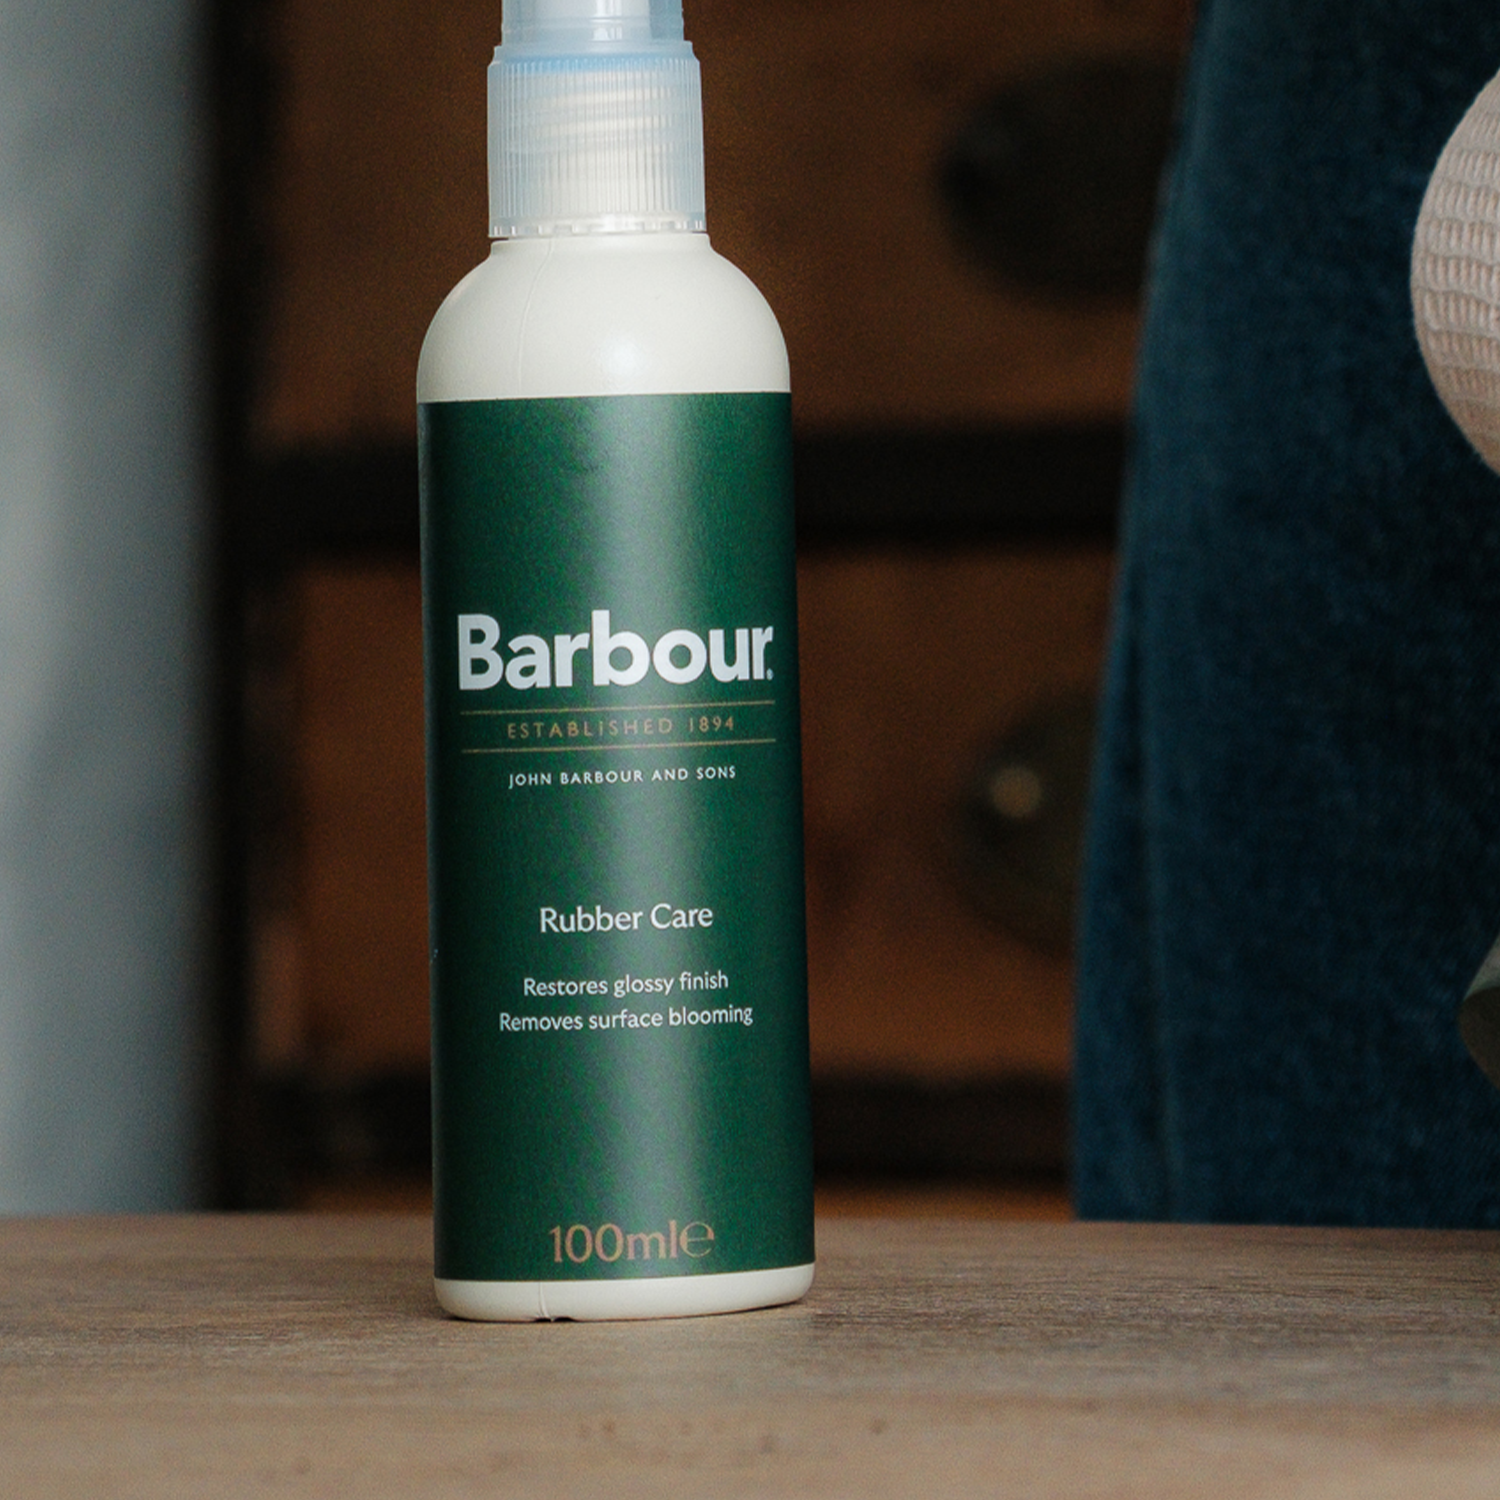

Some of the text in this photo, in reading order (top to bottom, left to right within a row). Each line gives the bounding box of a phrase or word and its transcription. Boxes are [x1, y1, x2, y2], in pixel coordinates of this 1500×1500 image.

[507, 715, 735, 739] ESTABLISHED 1894
[508, 765, 736, 789] JOHN BARBOUR AND SONS
[539, 903, 713, 933] Rubber Care
[523, 969, 729, 998] Restores glossy finish
[499, 1004, 754, 1032] Removes surface blooming
